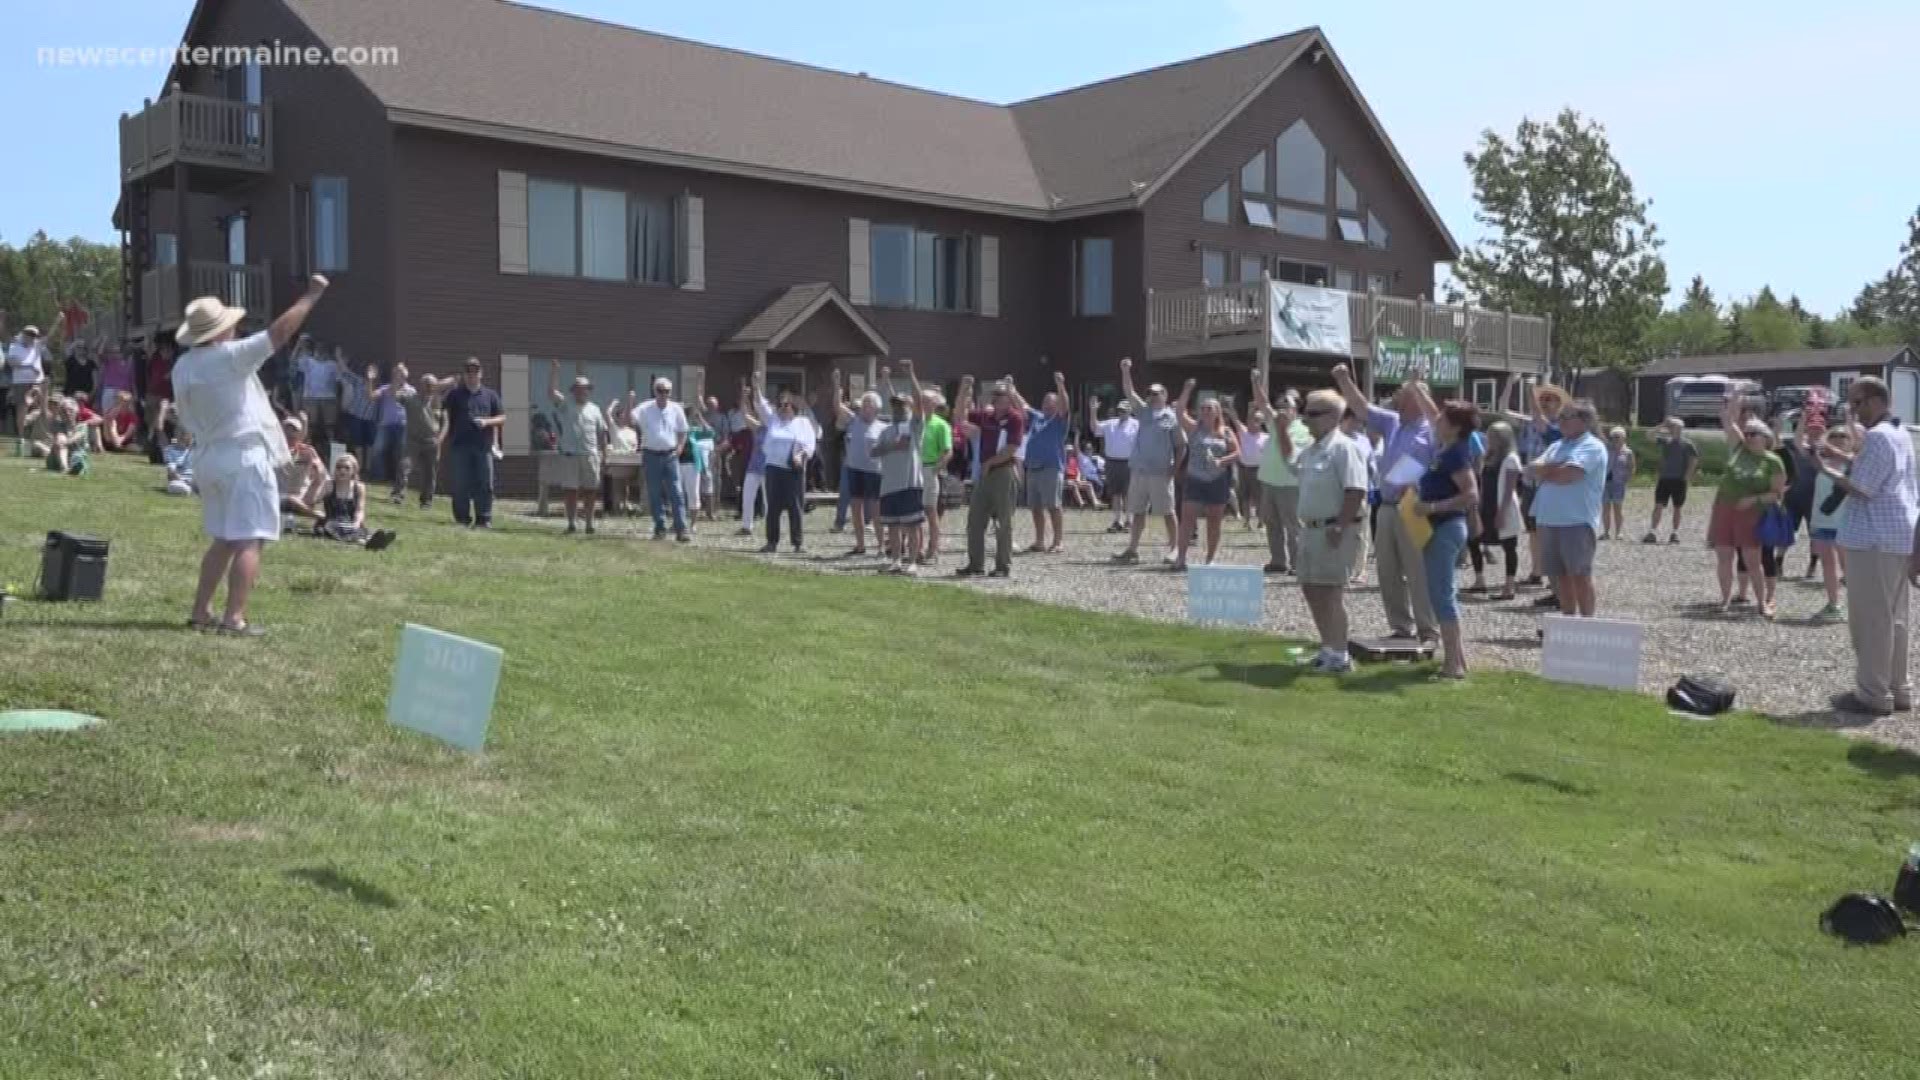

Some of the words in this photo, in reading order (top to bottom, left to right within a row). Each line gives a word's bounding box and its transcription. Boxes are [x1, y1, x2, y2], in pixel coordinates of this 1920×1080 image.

[1373, 341, 1407, 378] Save
[1409, 343, 1430, 379] the
[1434, 346, 1461, 382] Dam
